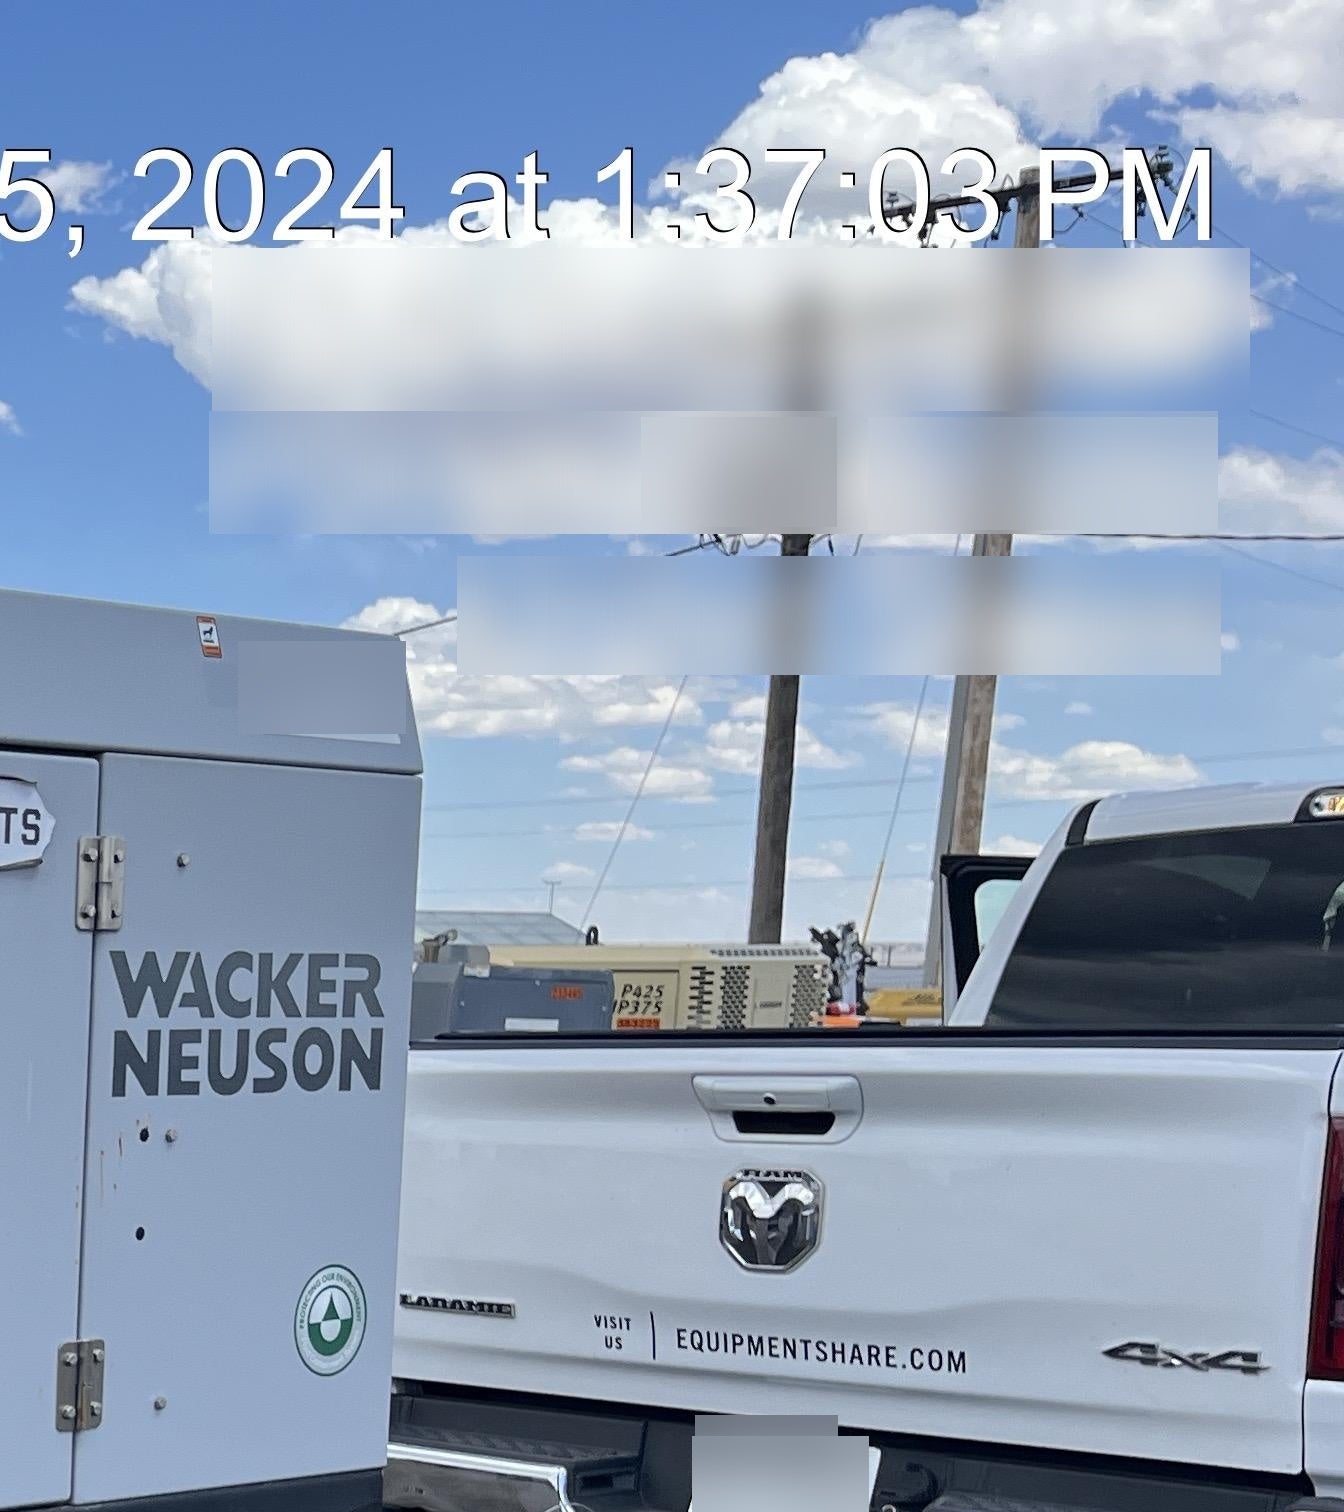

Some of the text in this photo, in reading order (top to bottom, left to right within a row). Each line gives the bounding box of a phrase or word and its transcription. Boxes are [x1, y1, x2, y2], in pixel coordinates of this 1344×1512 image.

[109, 950, 385, 1019] WACKER
[111, 1027, 384, 1097] NEUSON
[594, 1314, 631, 1331] VISIT
[604, 1336, 623, 1350] US
[676, 1328, 967, 1374] EQUIPMENTSHARE.COM
